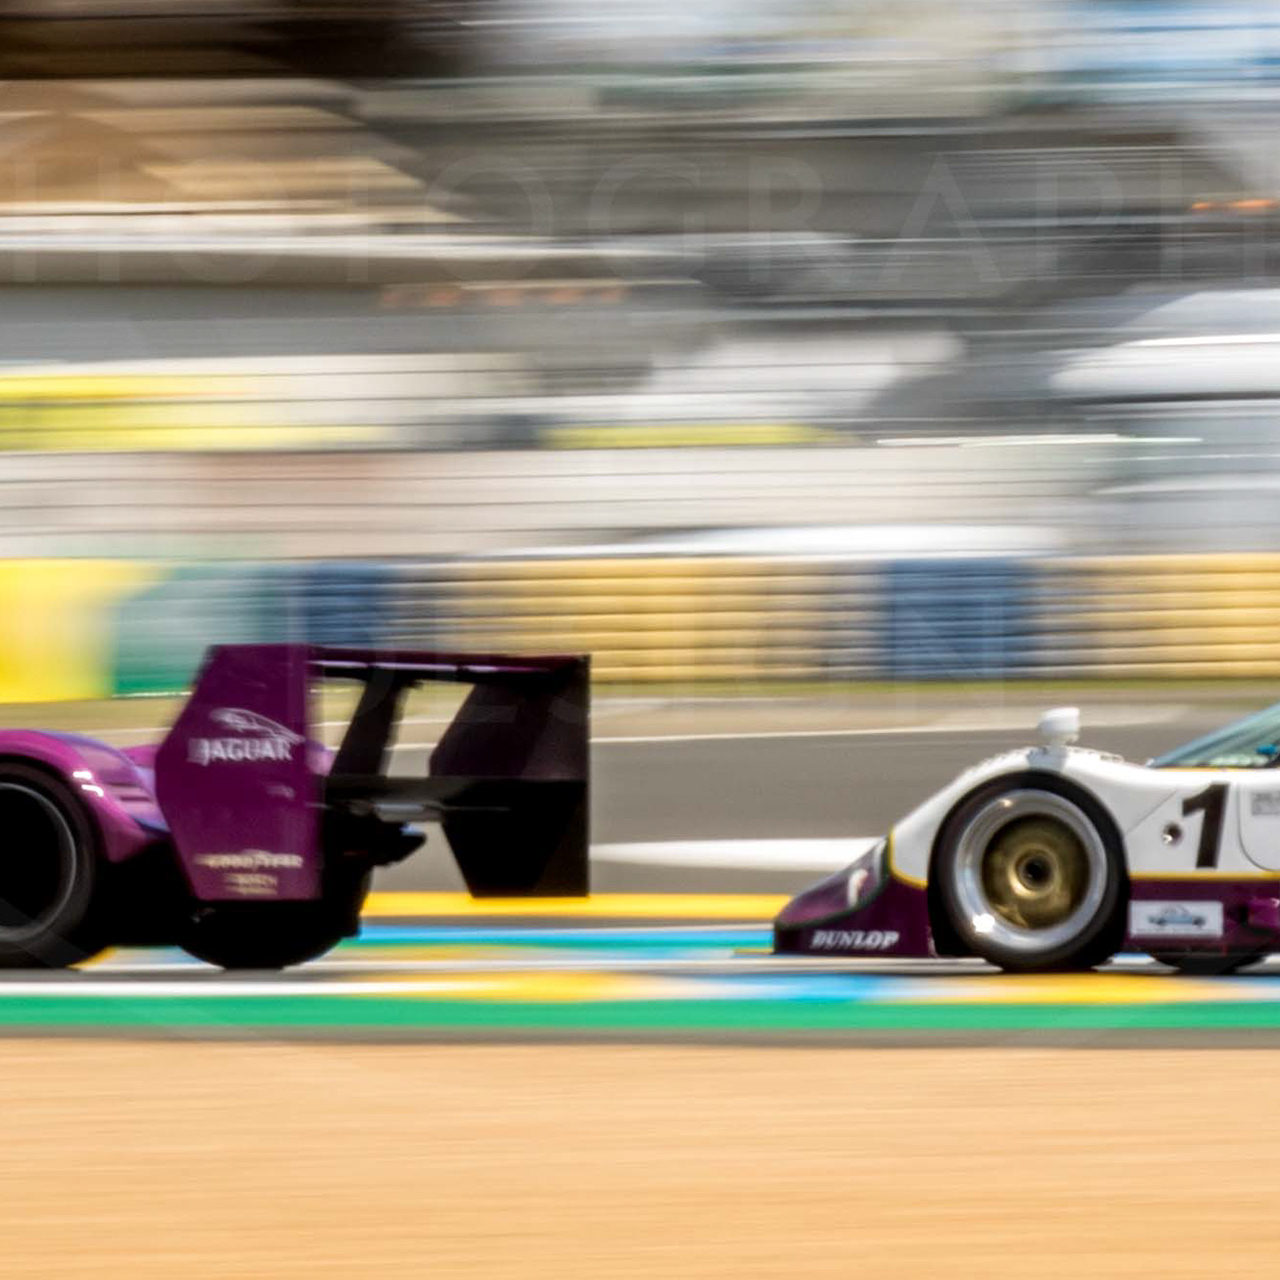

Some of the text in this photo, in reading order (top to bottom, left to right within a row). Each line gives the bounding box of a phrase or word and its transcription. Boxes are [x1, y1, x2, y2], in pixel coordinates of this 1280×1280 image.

[194, 738, 293, 765] JAGUAR
[1181, 781, 1230, 869] 1
[811, 929, 900, 950] DUNLOP
